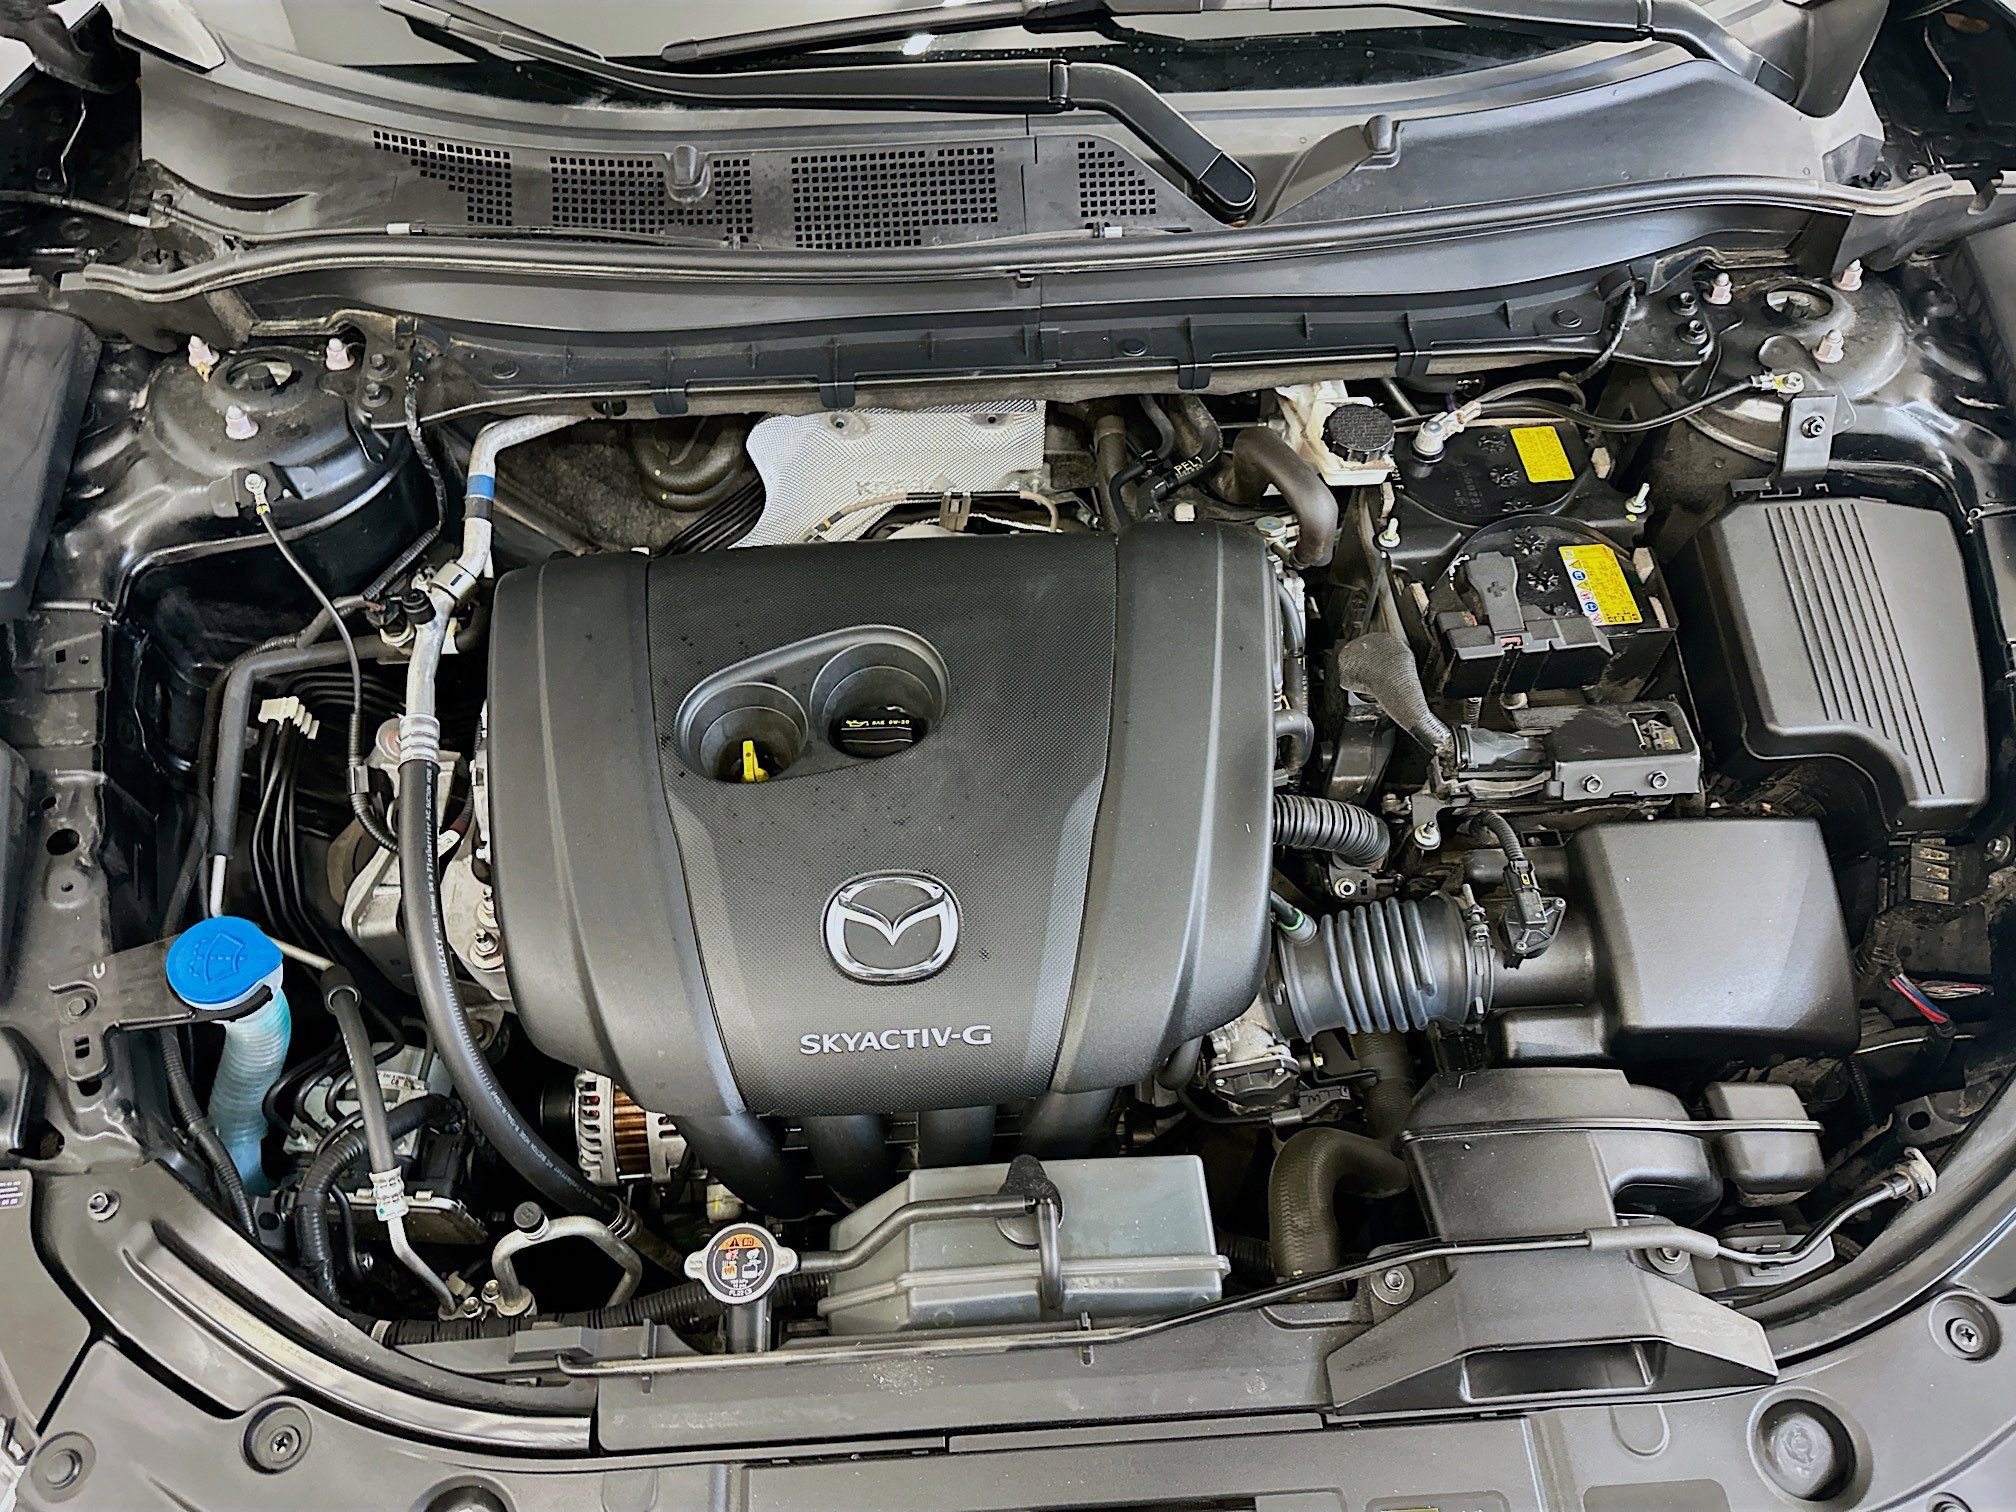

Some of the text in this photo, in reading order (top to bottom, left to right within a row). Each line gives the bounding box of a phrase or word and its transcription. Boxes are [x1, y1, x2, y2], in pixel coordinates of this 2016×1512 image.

[425, 784, 433, 809] SUCTION
[425, 821, 434, 873] Flexbarrier
[435, 937, 450, 977] GALAXY
[799, 1024, 993, 1055] SKYACTIV-G
